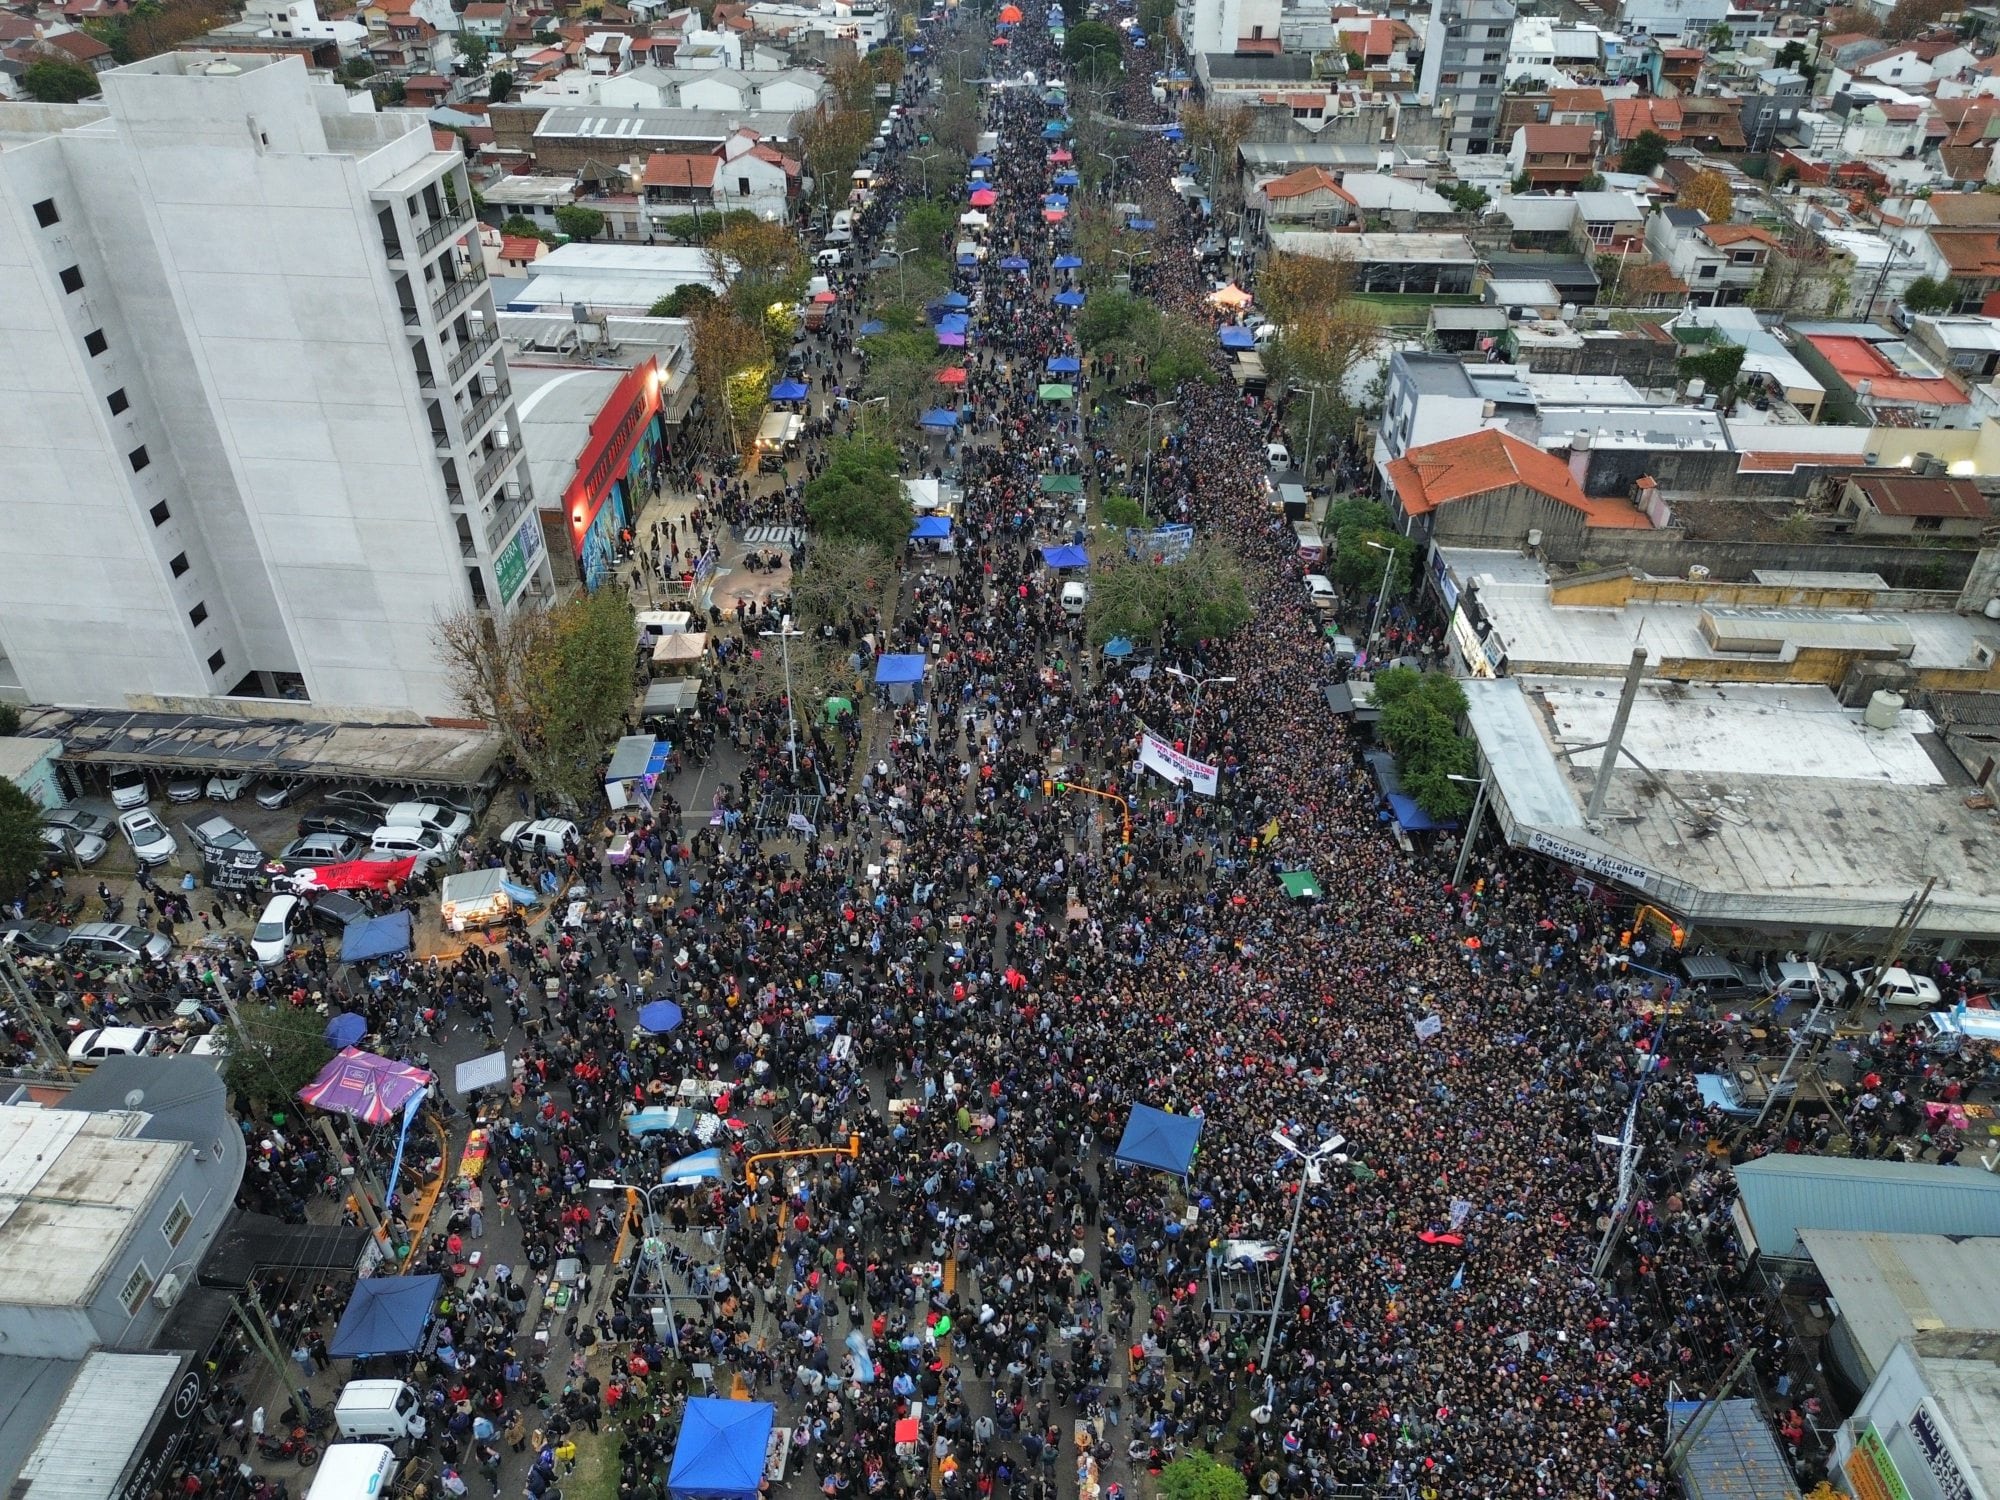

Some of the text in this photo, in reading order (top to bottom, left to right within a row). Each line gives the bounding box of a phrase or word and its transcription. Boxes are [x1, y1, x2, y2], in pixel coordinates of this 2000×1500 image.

[1535, 833, 1587, 859] Graciosos
[1539, 844, 1623, 879] Cristina Libre
[150, 1432, 177, 1480] Lunch
[1918, 1405, 1971, 1500] CULTURAL
[1934, 1453, 1964, 1500] DOMI
